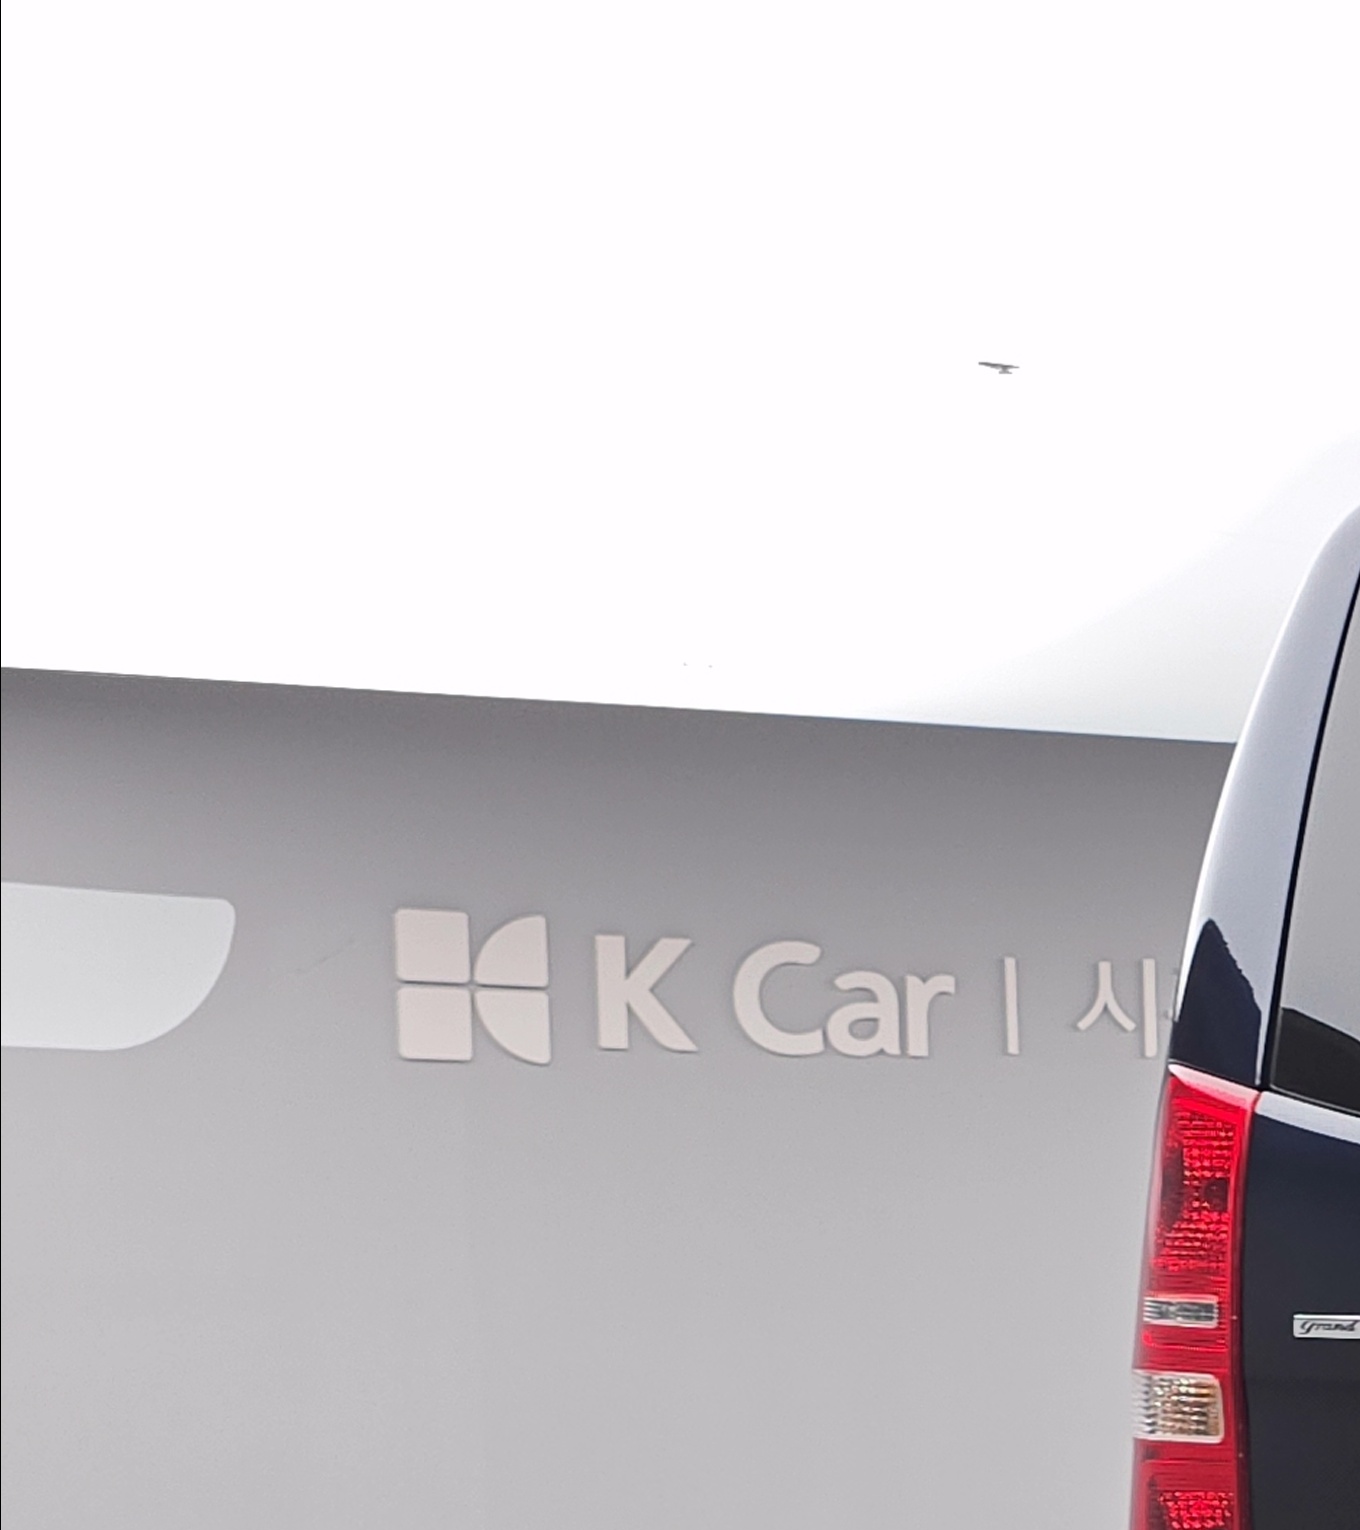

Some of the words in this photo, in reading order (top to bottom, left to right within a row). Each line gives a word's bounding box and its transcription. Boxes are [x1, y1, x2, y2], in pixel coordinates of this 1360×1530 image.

[593, 934, 700, 1054] K
[732, 939, 957, 1058] Car
[1076, 958, 1176, 1058] 시
